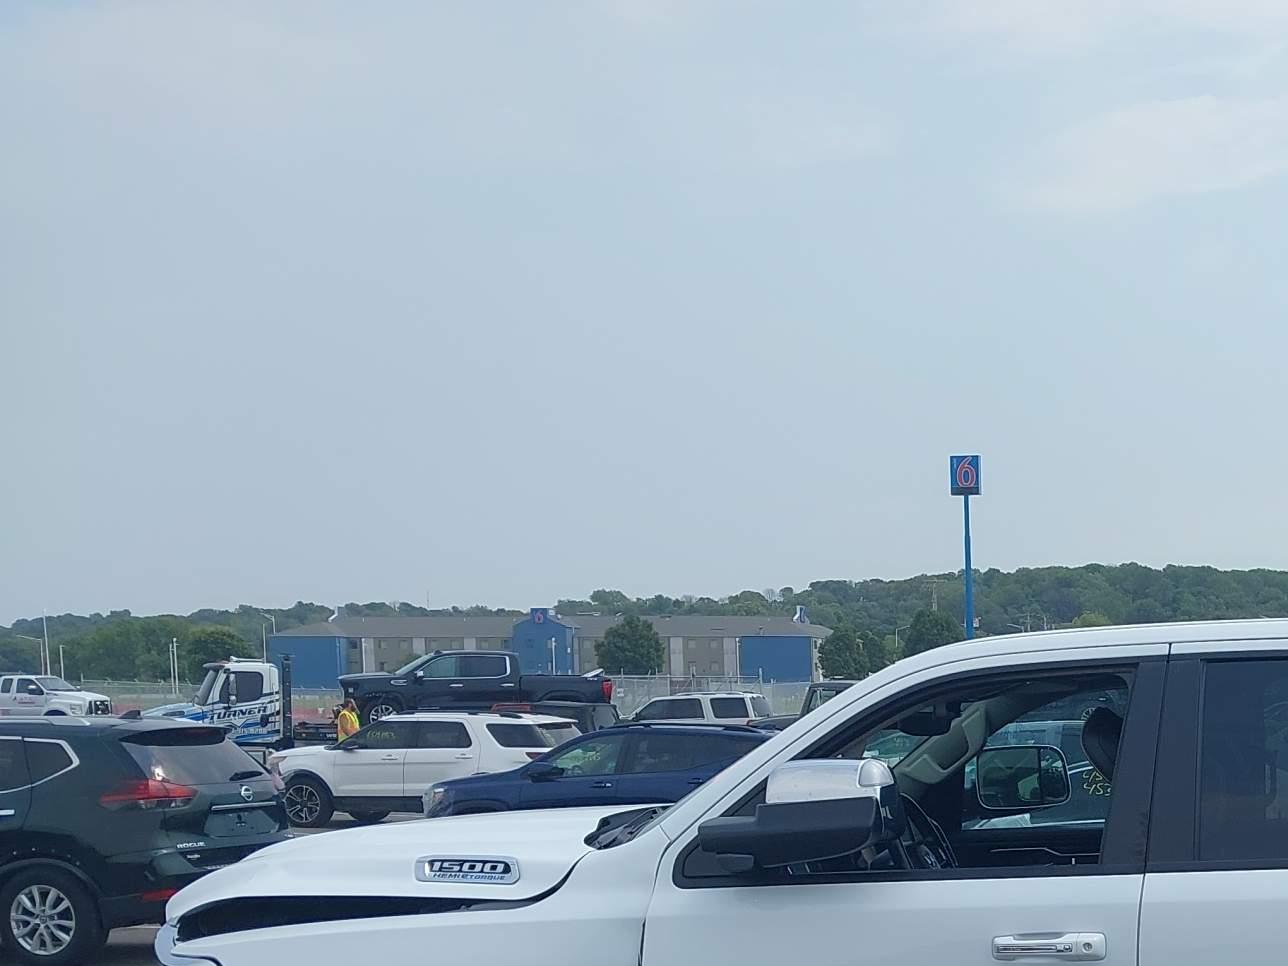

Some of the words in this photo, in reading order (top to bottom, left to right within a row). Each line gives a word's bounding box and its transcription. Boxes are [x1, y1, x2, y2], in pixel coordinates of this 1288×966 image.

[956, 456, 976, 488] 6
[208, 705, 268, 721] TURNER
[176, 841, 208, 849] ROGUE
[431, 861, 506, 873] 1500
[432, 872, 460, 880] HEMI
